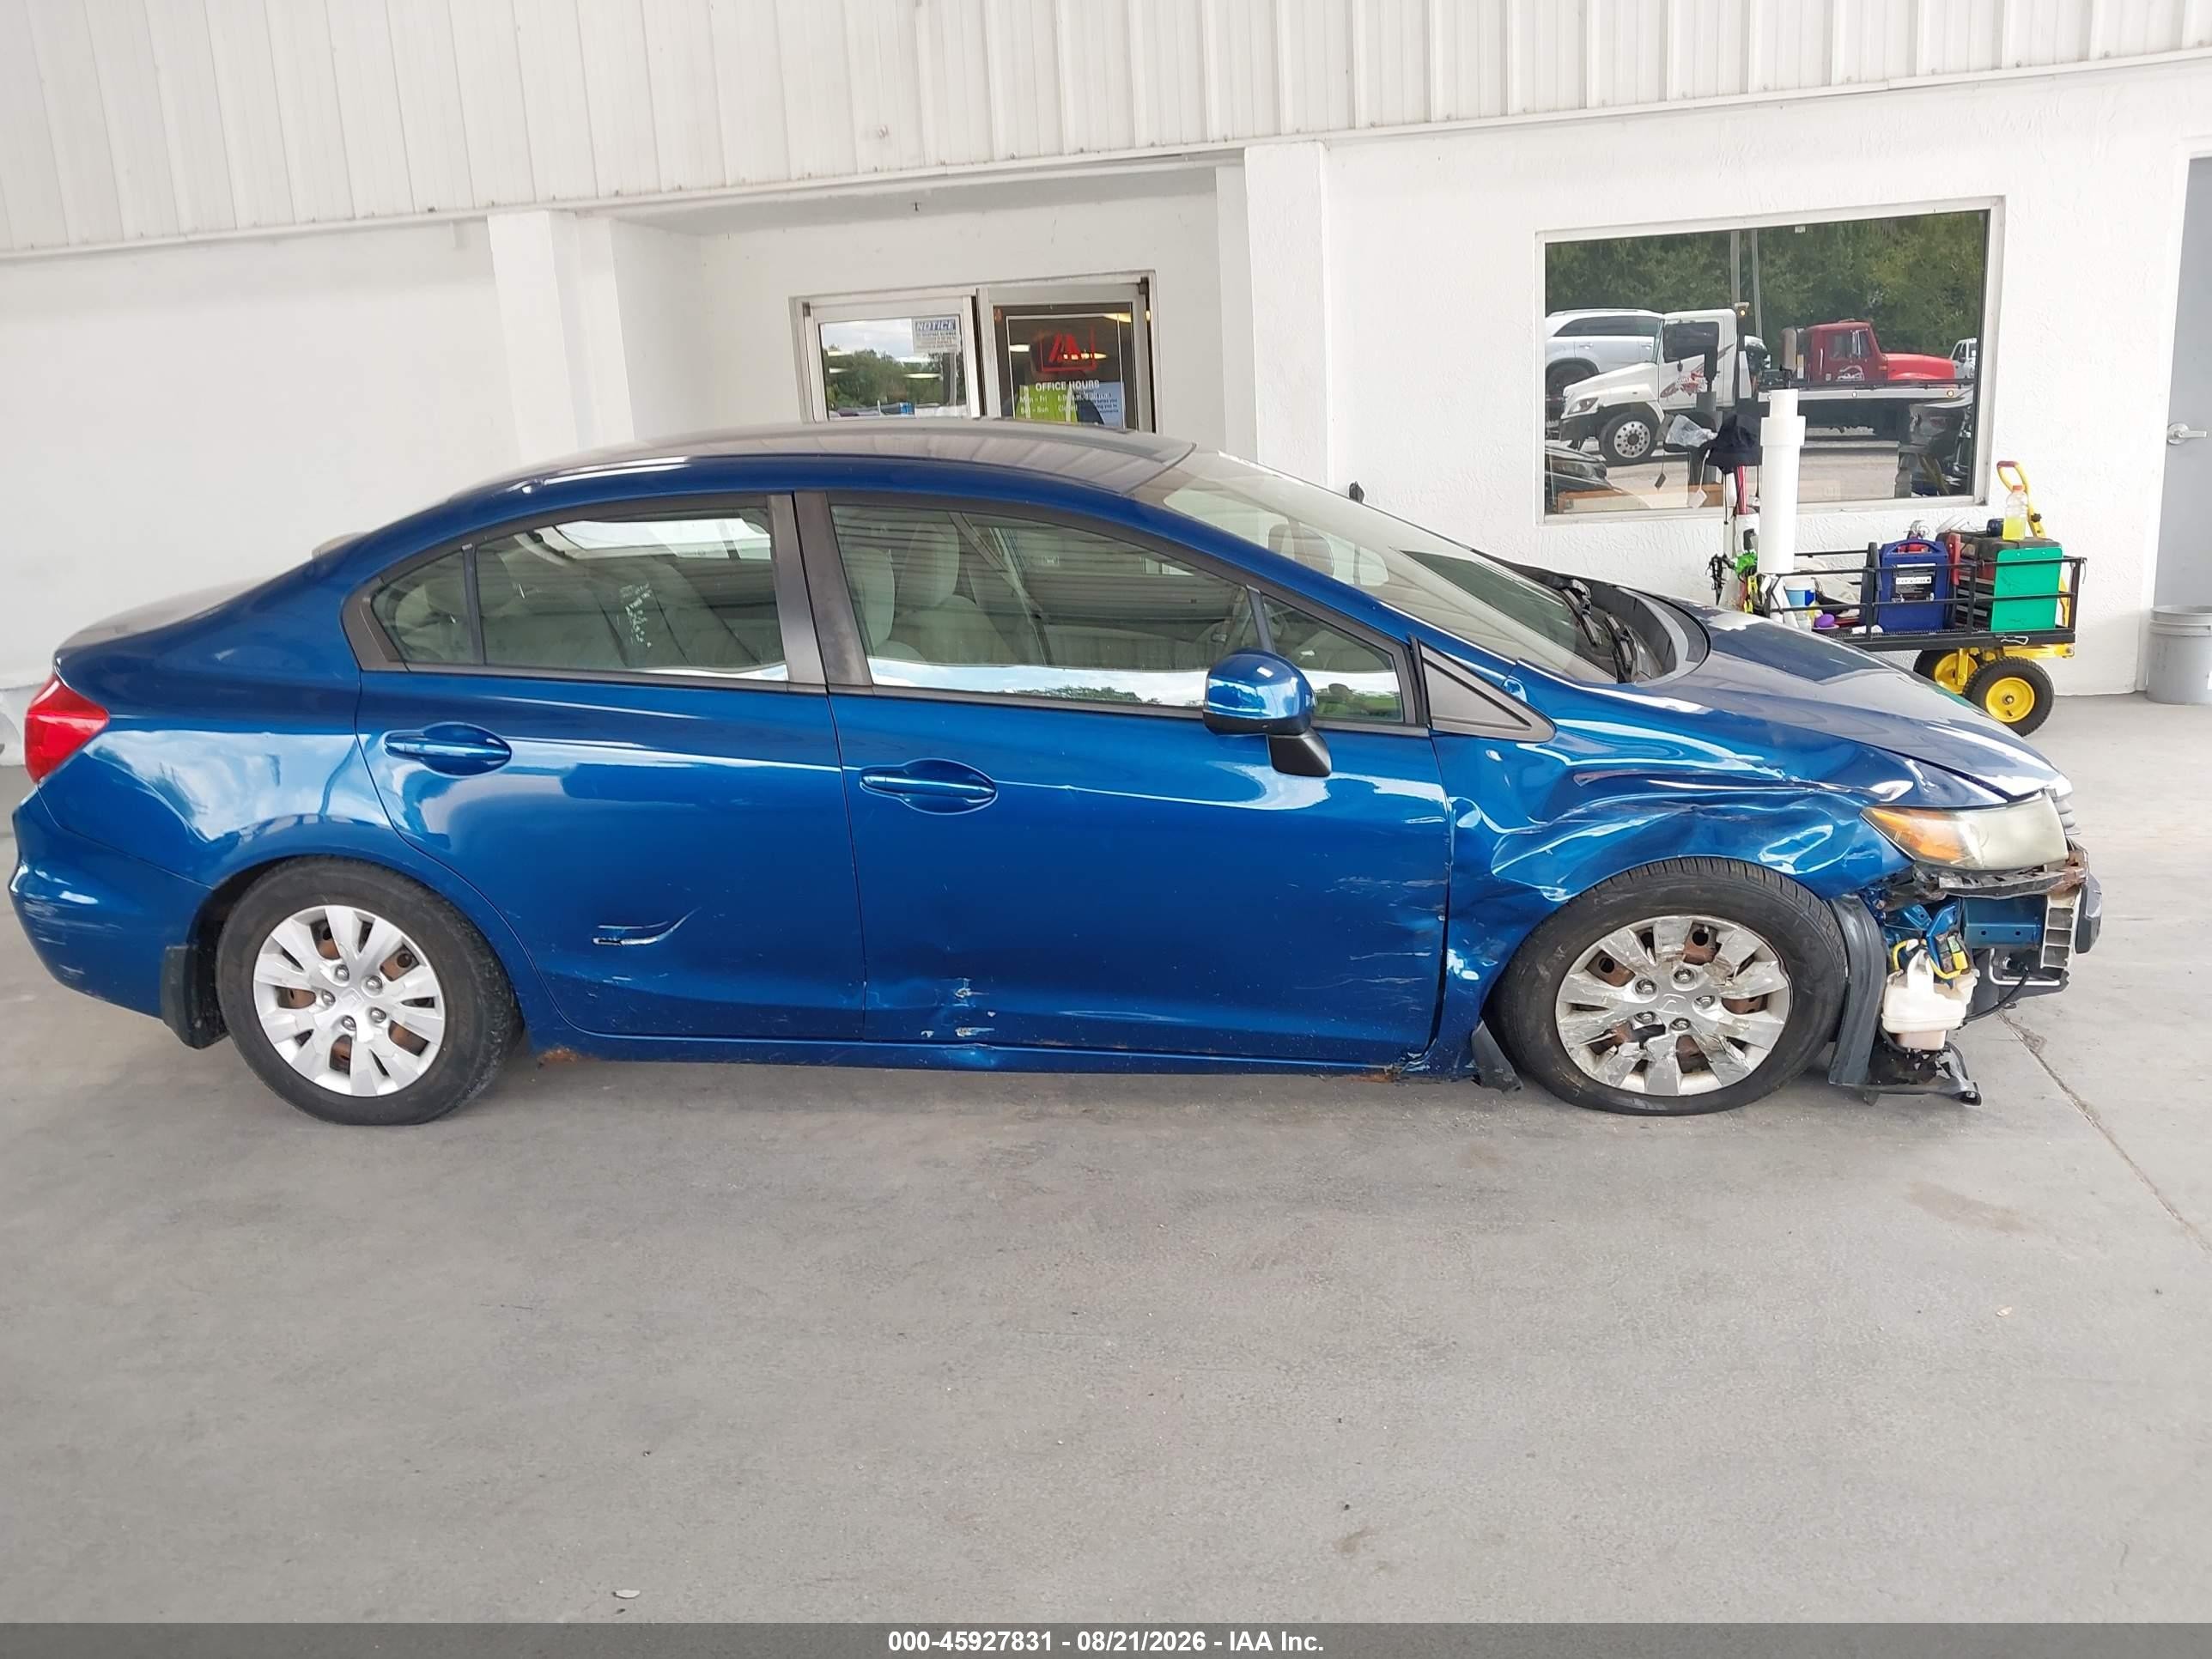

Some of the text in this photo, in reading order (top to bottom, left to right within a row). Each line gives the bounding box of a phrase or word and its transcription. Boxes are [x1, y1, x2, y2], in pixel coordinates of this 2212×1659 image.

[916, 319, 956, 331] NOTICE
[1036, 380, 1100, 392] OFFICE HOURS
[1020, 395, 1034, 404] Mn
